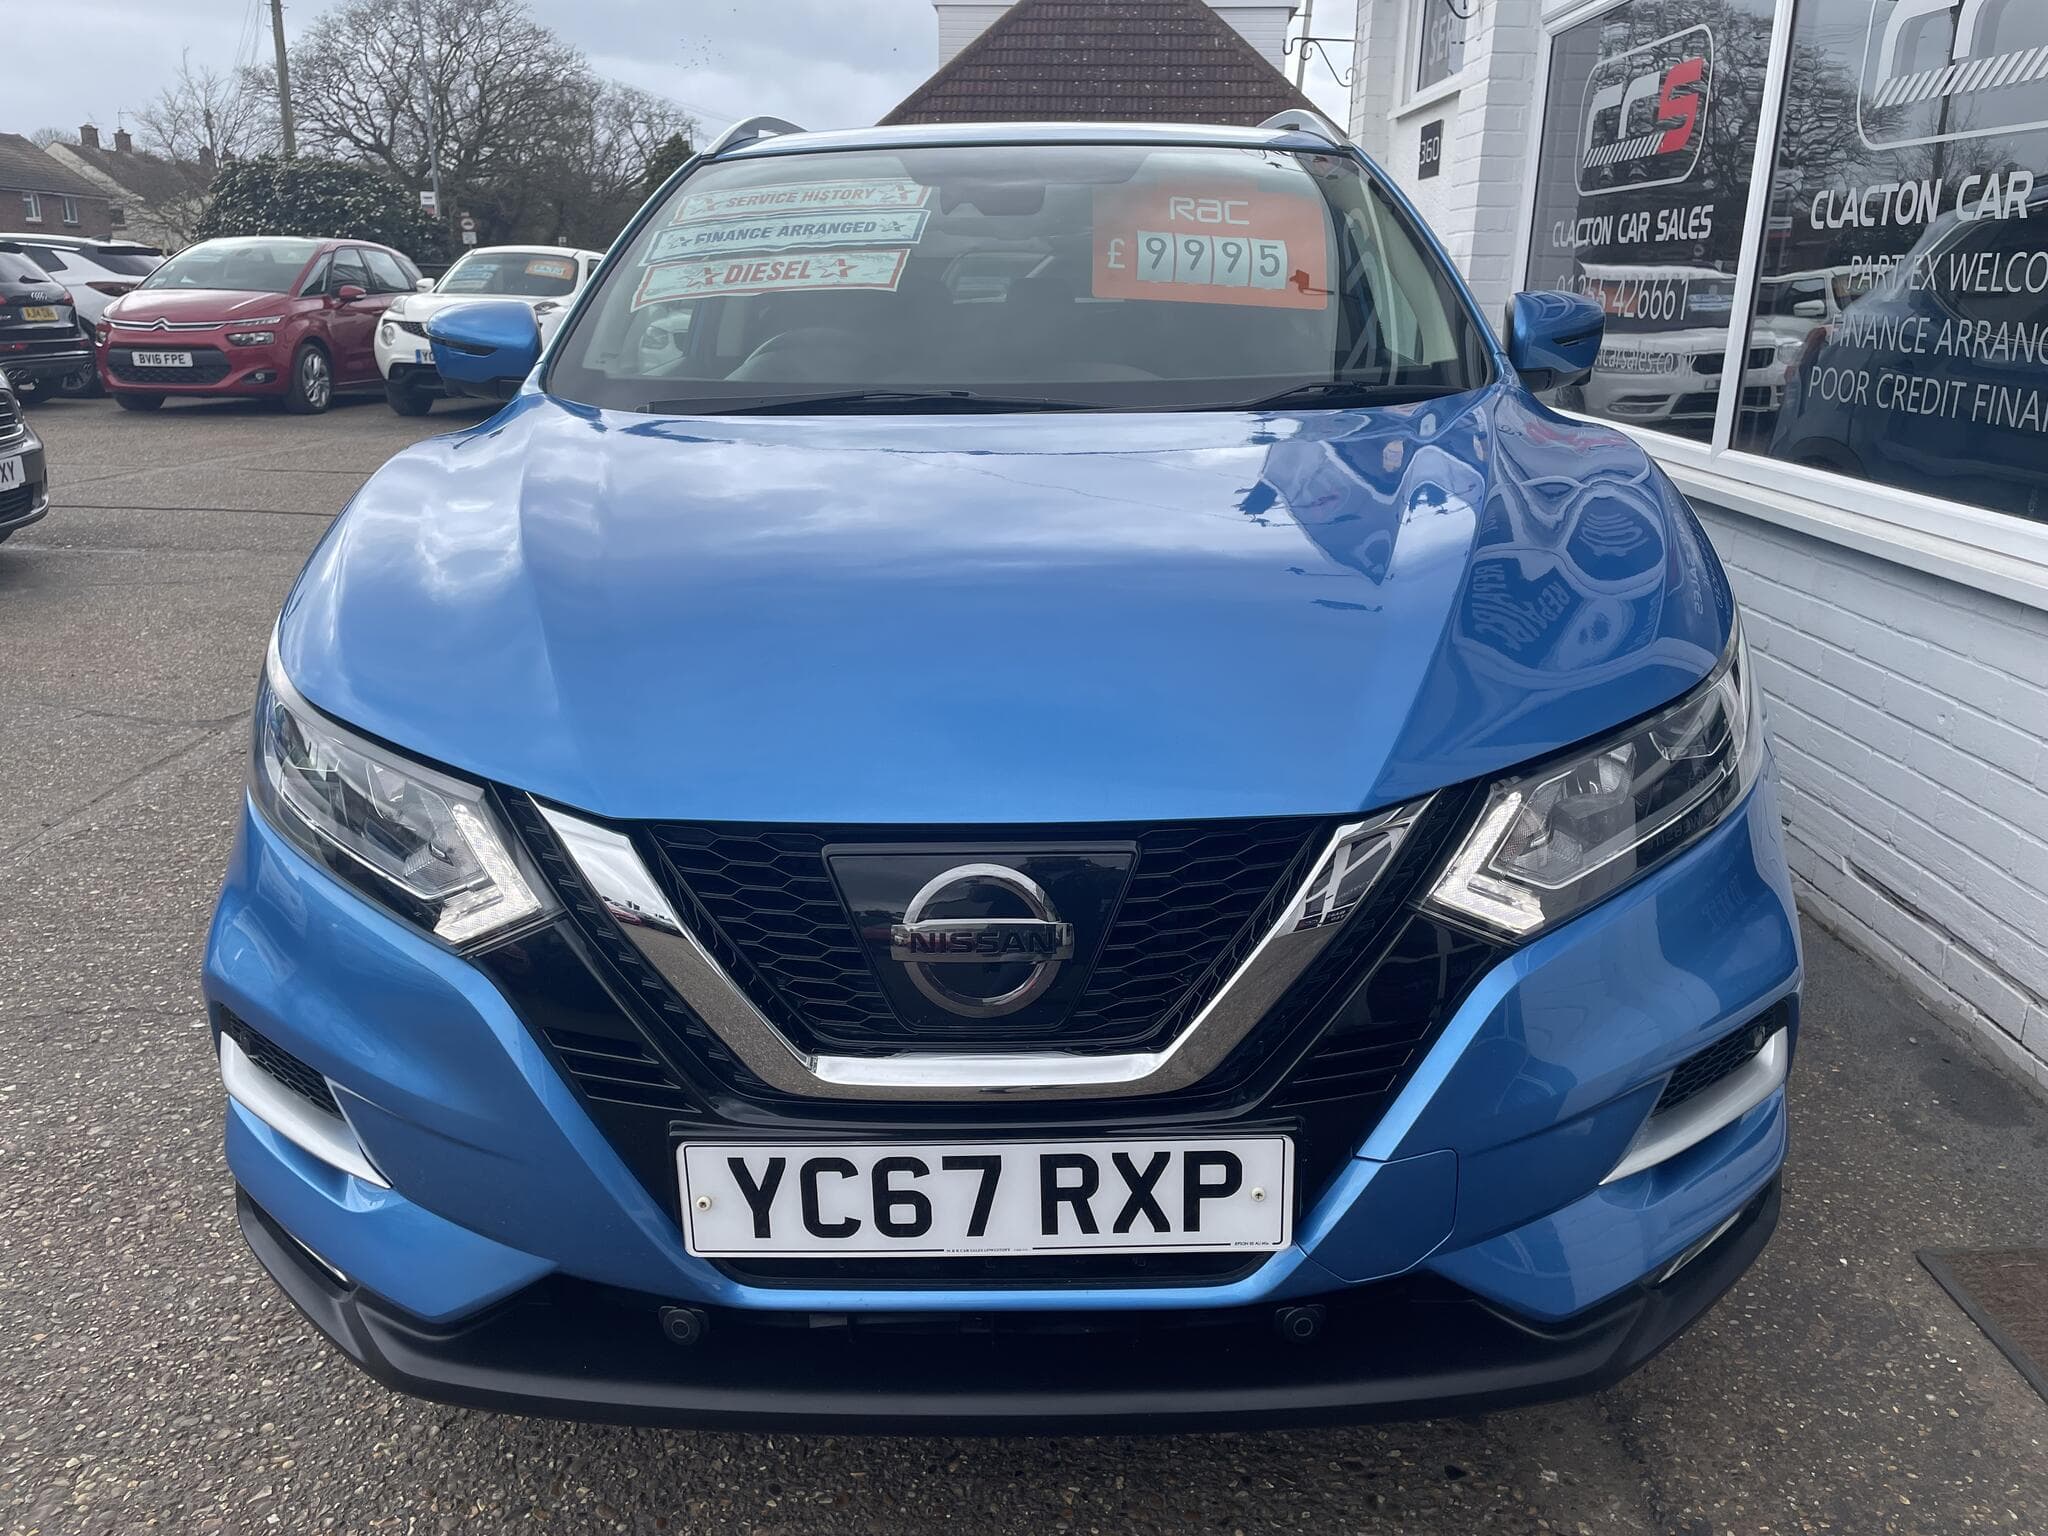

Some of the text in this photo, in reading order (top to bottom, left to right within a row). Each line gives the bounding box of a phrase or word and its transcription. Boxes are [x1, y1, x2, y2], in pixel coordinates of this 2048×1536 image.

[1420, 136, 1440, 165] 360
[725, 187, 876, 208] SERVICE HISTORY
[1810, 170, 2034, 230] CLACTON CAR
[694, 221, 877, 245] FINANCE ARRANGED
[1552, 204, 1714, 248] CLACTON CAR SALES
[723, 260, 811, 284] DIESEL
[1107, 237, 1281, 278] £ 9995
[1847, 251, 2048, 293] PART EX WELCO
[1612, 276, 1689, 321] 426661
[1828, 313, 1930, 354] FINANCE
[139, 353, 186, 365] BV16 FPE
[1808, 365, 2048, 433] POOR CREDIT FINA
[910, 932, 1056, 954] NISSAN
[727, 1150, 1243, 1239] YC67 RXP
